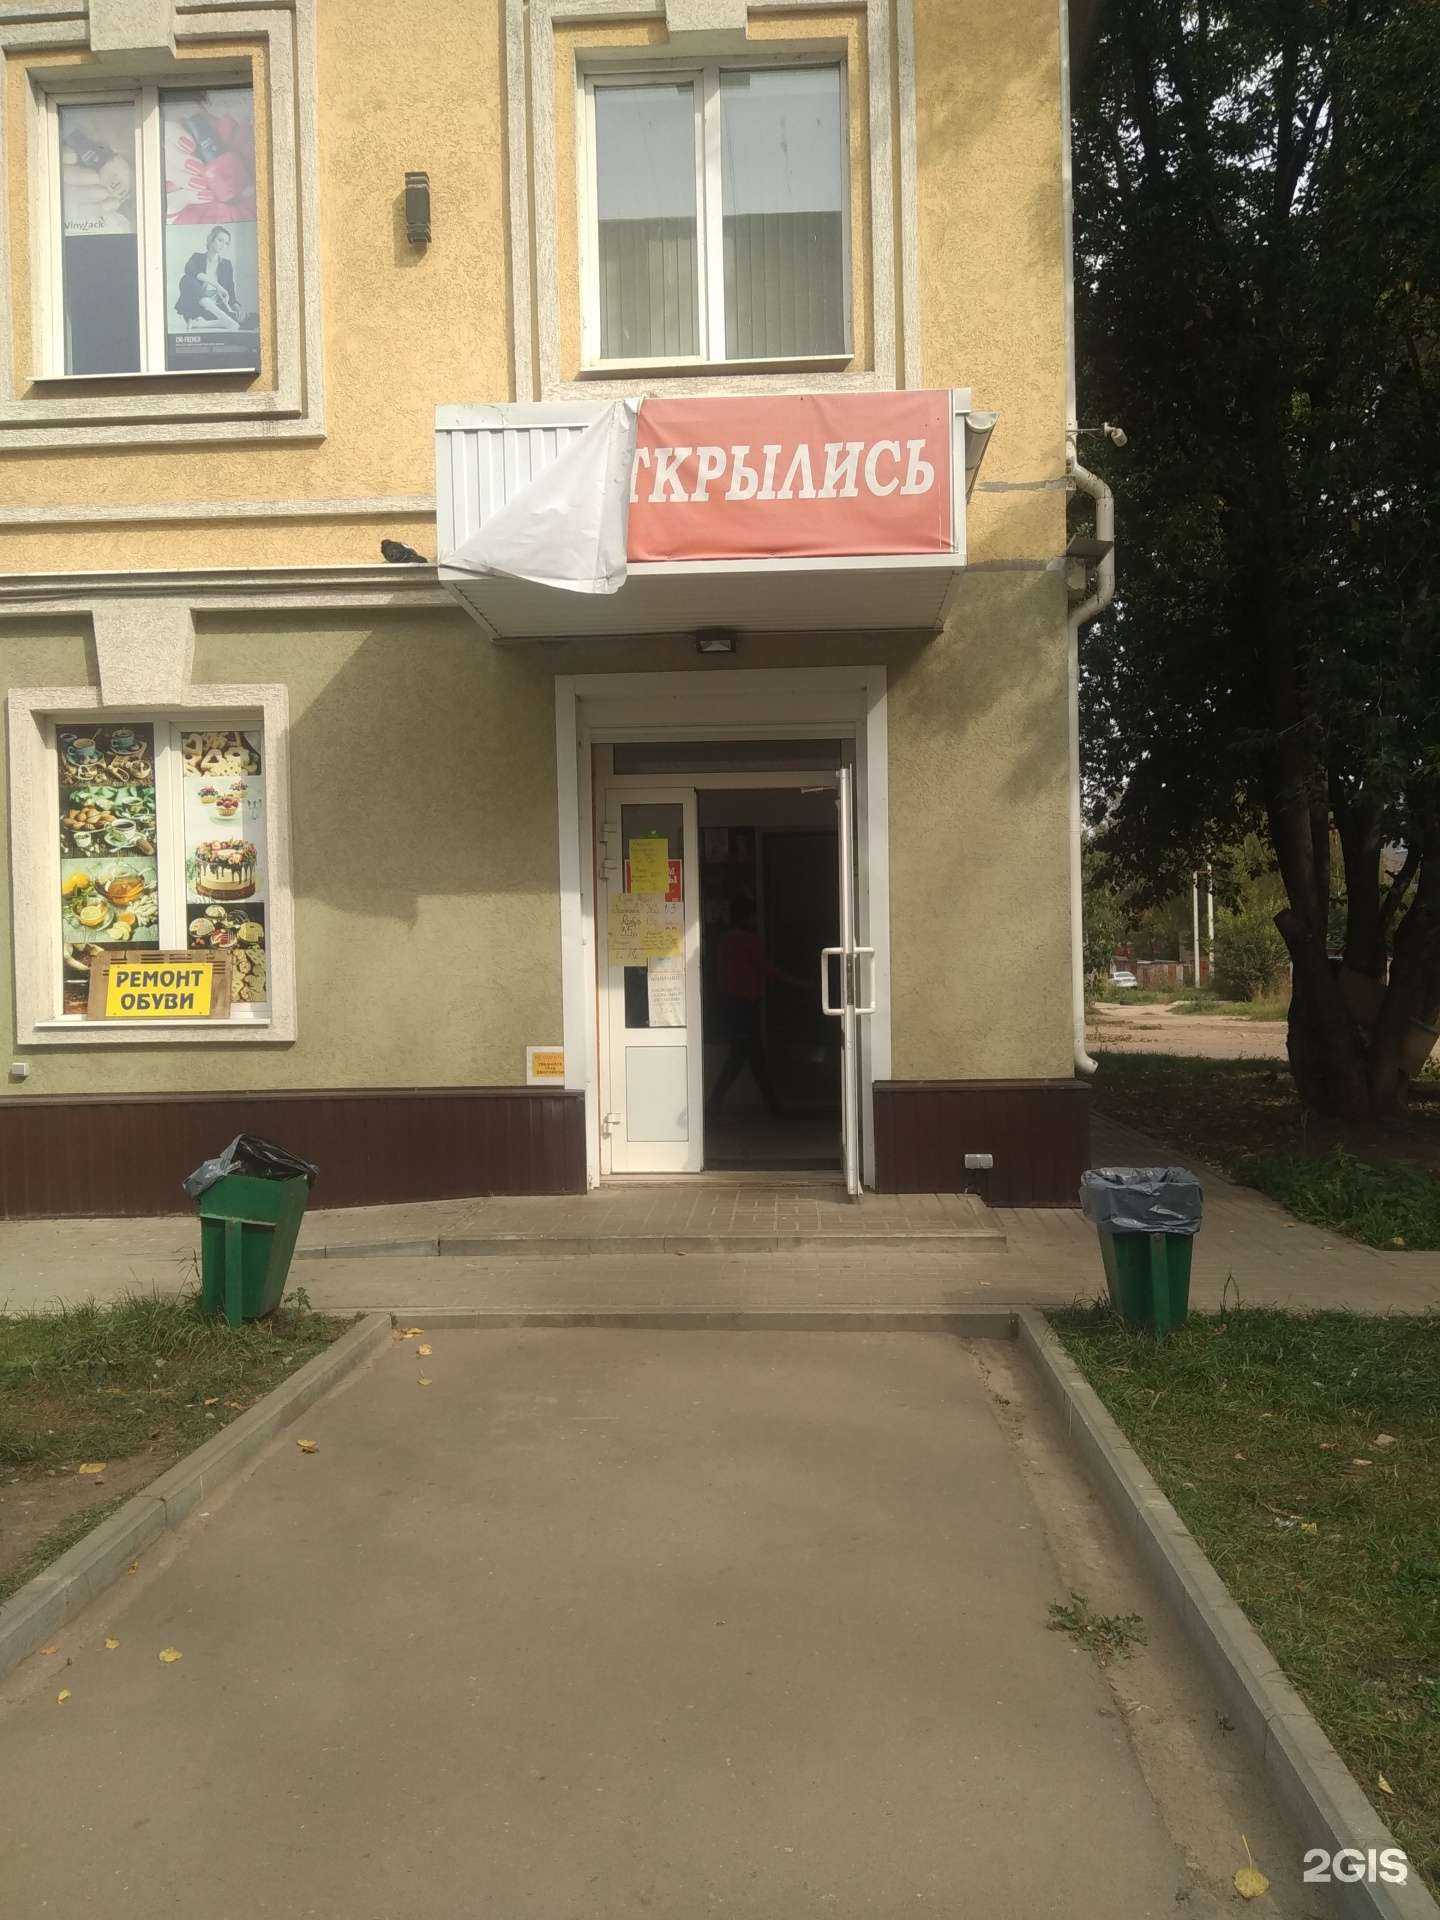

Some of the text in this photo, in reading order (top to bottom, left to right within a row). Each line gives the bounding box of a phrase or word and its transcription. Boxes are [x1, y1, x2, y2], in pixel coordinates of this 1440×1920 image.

[629, 439, 935, 503] ТКРЫЛИСЬ
[116, 970, 203, 988] РЕМОНТ
[120, 993, 194, 1010] ОБУВИ
